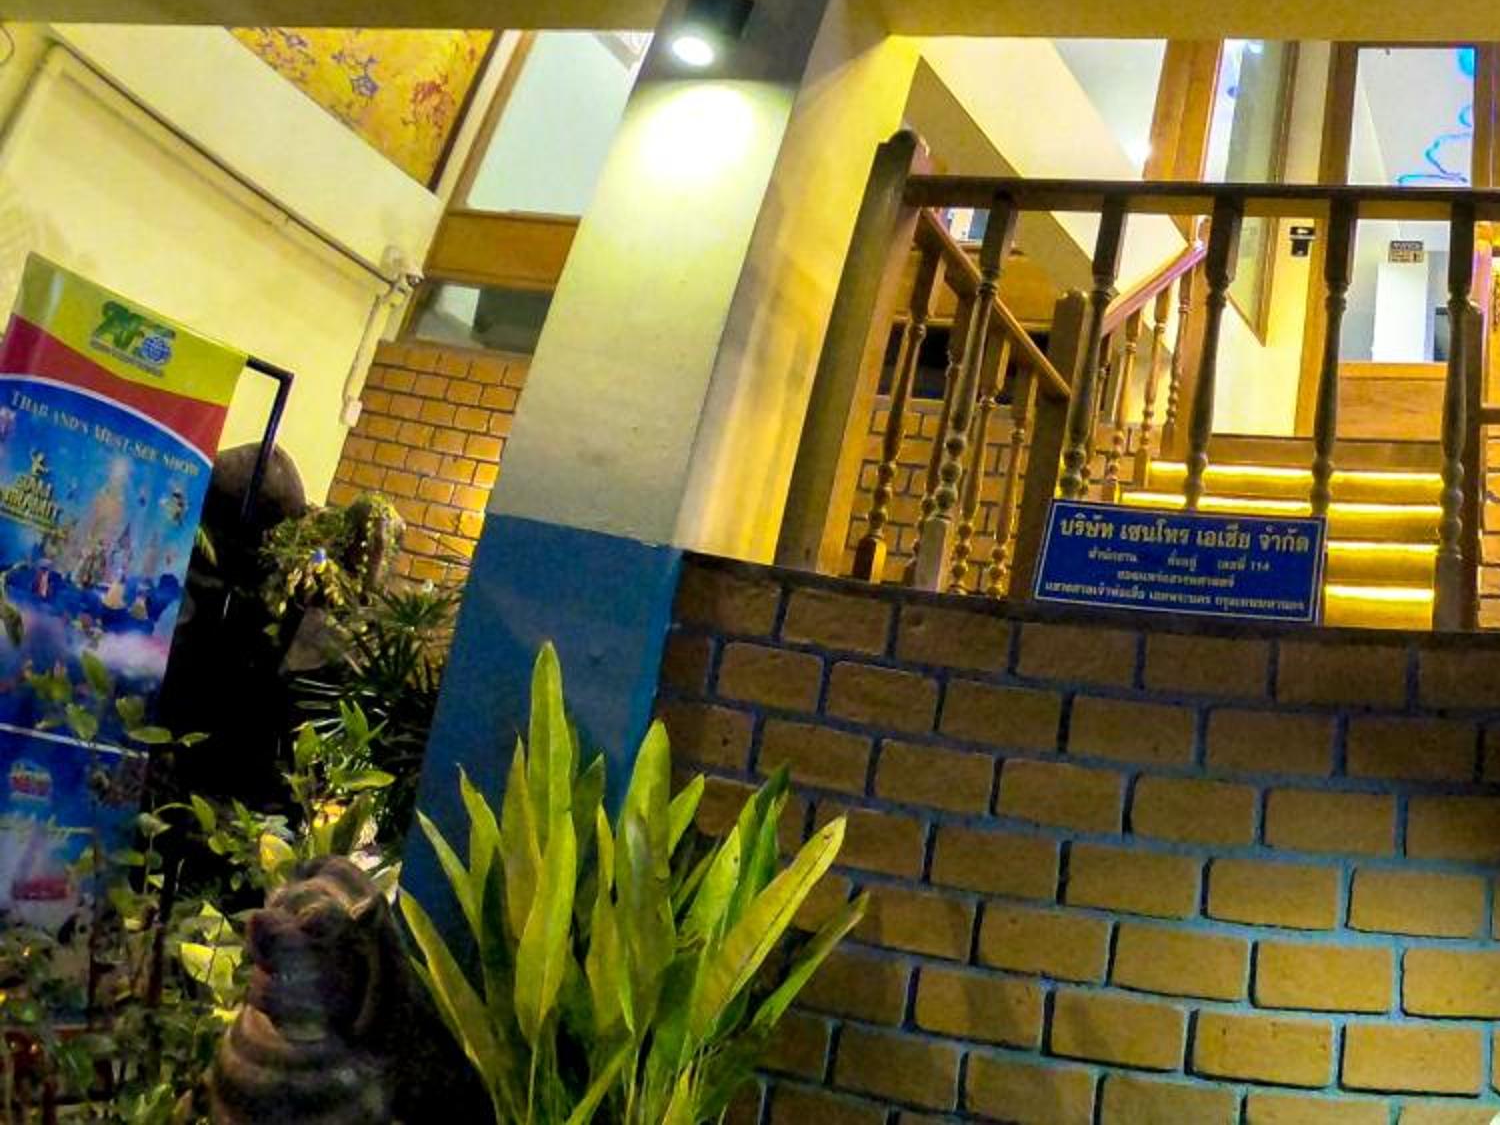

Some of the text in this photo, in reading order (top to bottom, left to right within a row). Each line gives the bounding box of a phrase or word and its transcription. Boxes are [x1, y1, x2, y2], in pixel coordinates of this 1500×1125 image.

[1059, 512, 1114, 539] บริษัท
[1259, 525, 1310, 553] จำกัด
